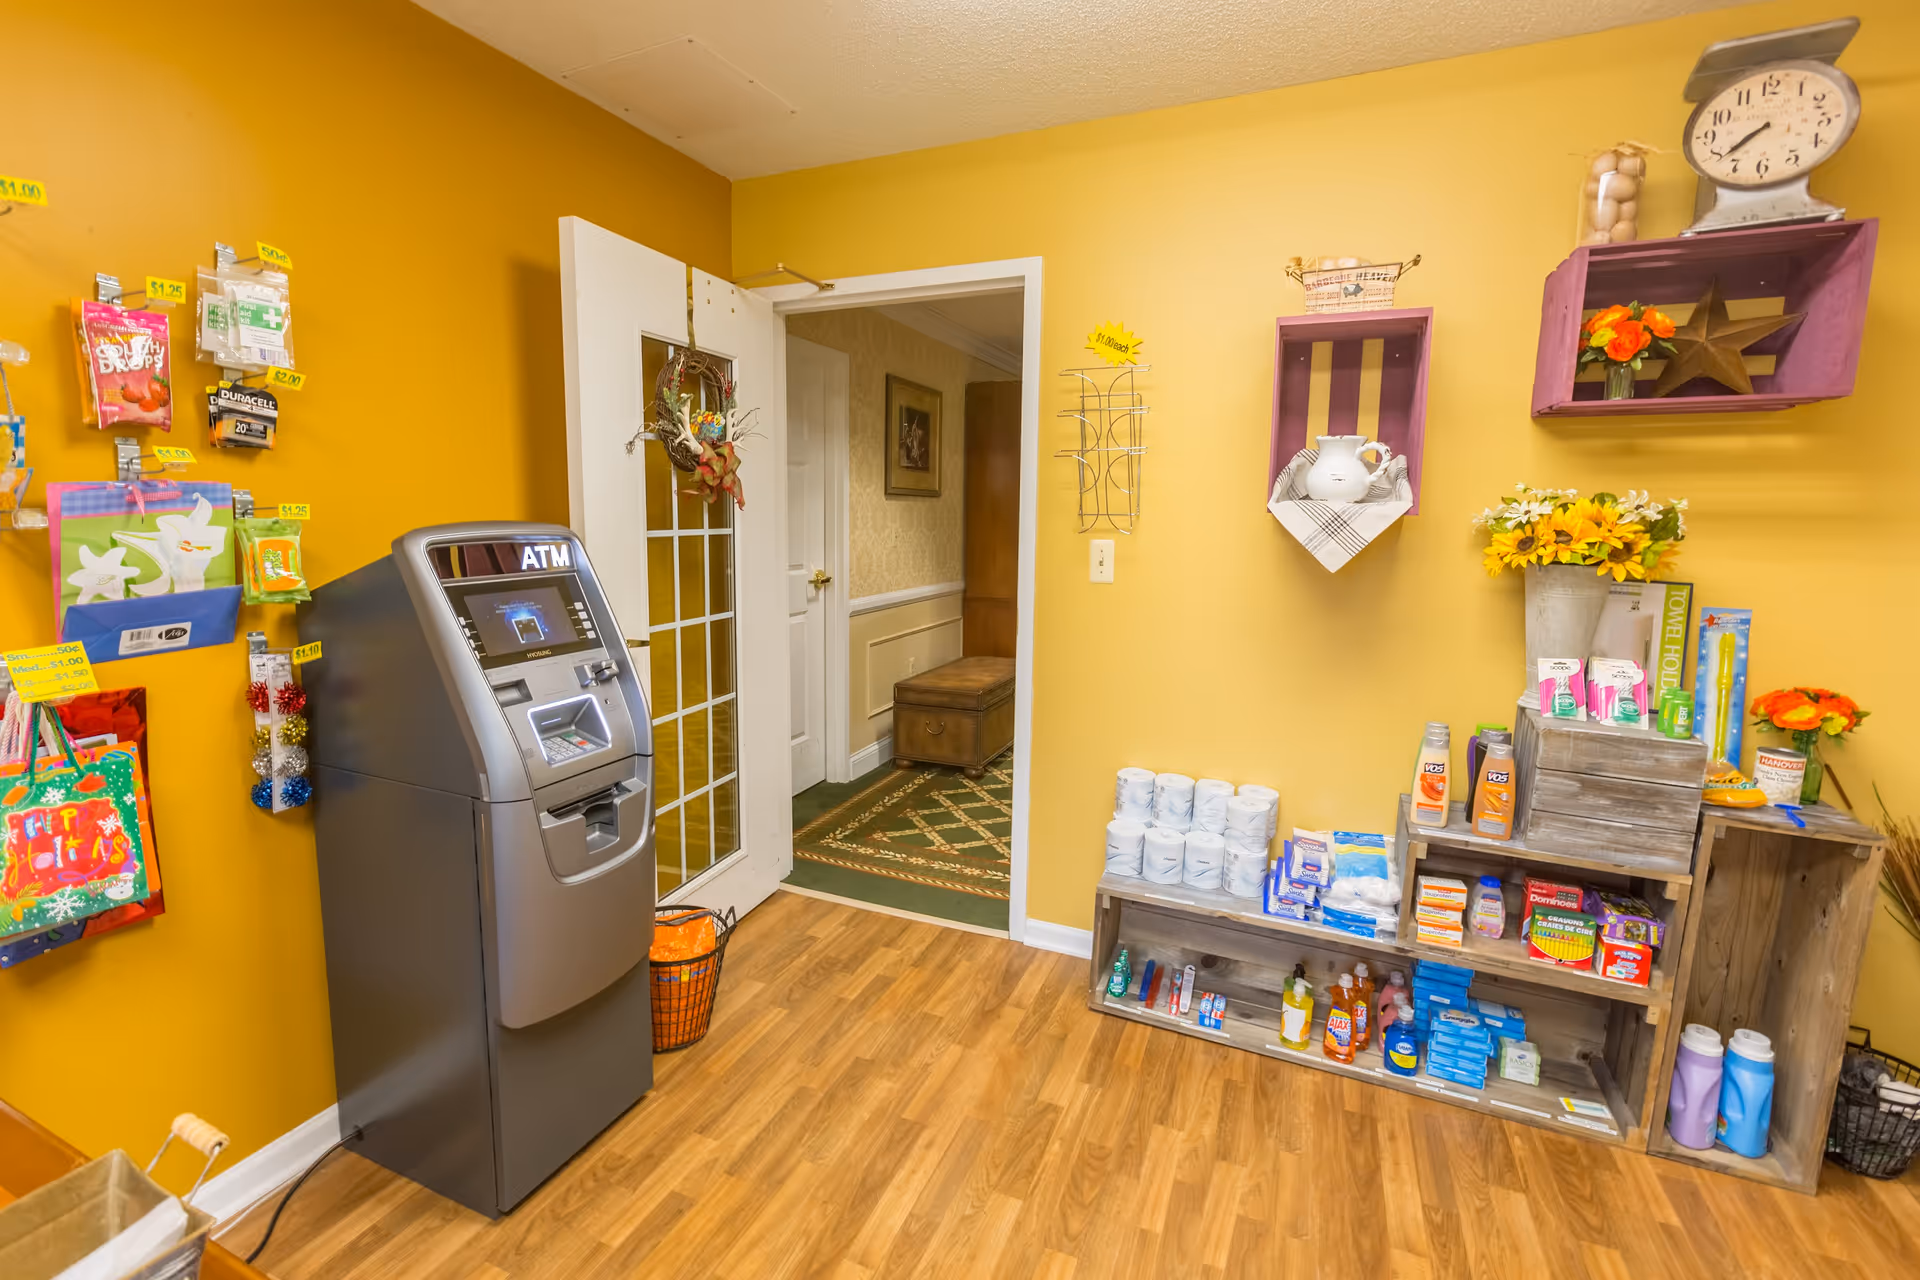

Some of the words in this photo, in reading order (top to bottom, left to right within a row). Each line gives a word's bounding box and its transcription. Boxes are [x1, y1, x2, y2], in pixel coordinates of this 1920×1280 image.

[1762, 75, 1781, 96] 12
[1734, 88, 1751, 106] 11
[1813, 93, 1826, 109] 2
[1712, 108, 1732, 126] 10
[1817, 111, 1832, 127] 3
[1703, 129, 1717, 146] 9
[1812, 132, 1828, 148] 4
[1730, 158, 1741, 173] 7
[1755, 158, 1769, 175] 6
[1785, 150, 1800, 167] 5
[0, 179, 42, 200] $1.00
[150, 280, 183, 299] $1.25
[273, 369, 301, 386] $2.00
[221, 389, 276, 410] DURACELL
[281, 505, 308, 517] $1.25
[521, 544, 570, 570] ATM
[1665, 587, 1688, 642] TOWEL
[295, 644, 319, 660] $1.10
[1659, 645, 1682, 697] HOLD
[1424, 891, 1452, 899] Ibuprofen
[1529, 893, 1578, 909] Dominoes
[1537, 920, 1564, 930] CRAIES
[1547, 915, 1585, 927] CRAYONS
[1329, 1017, 1350, 1031] AJAX
